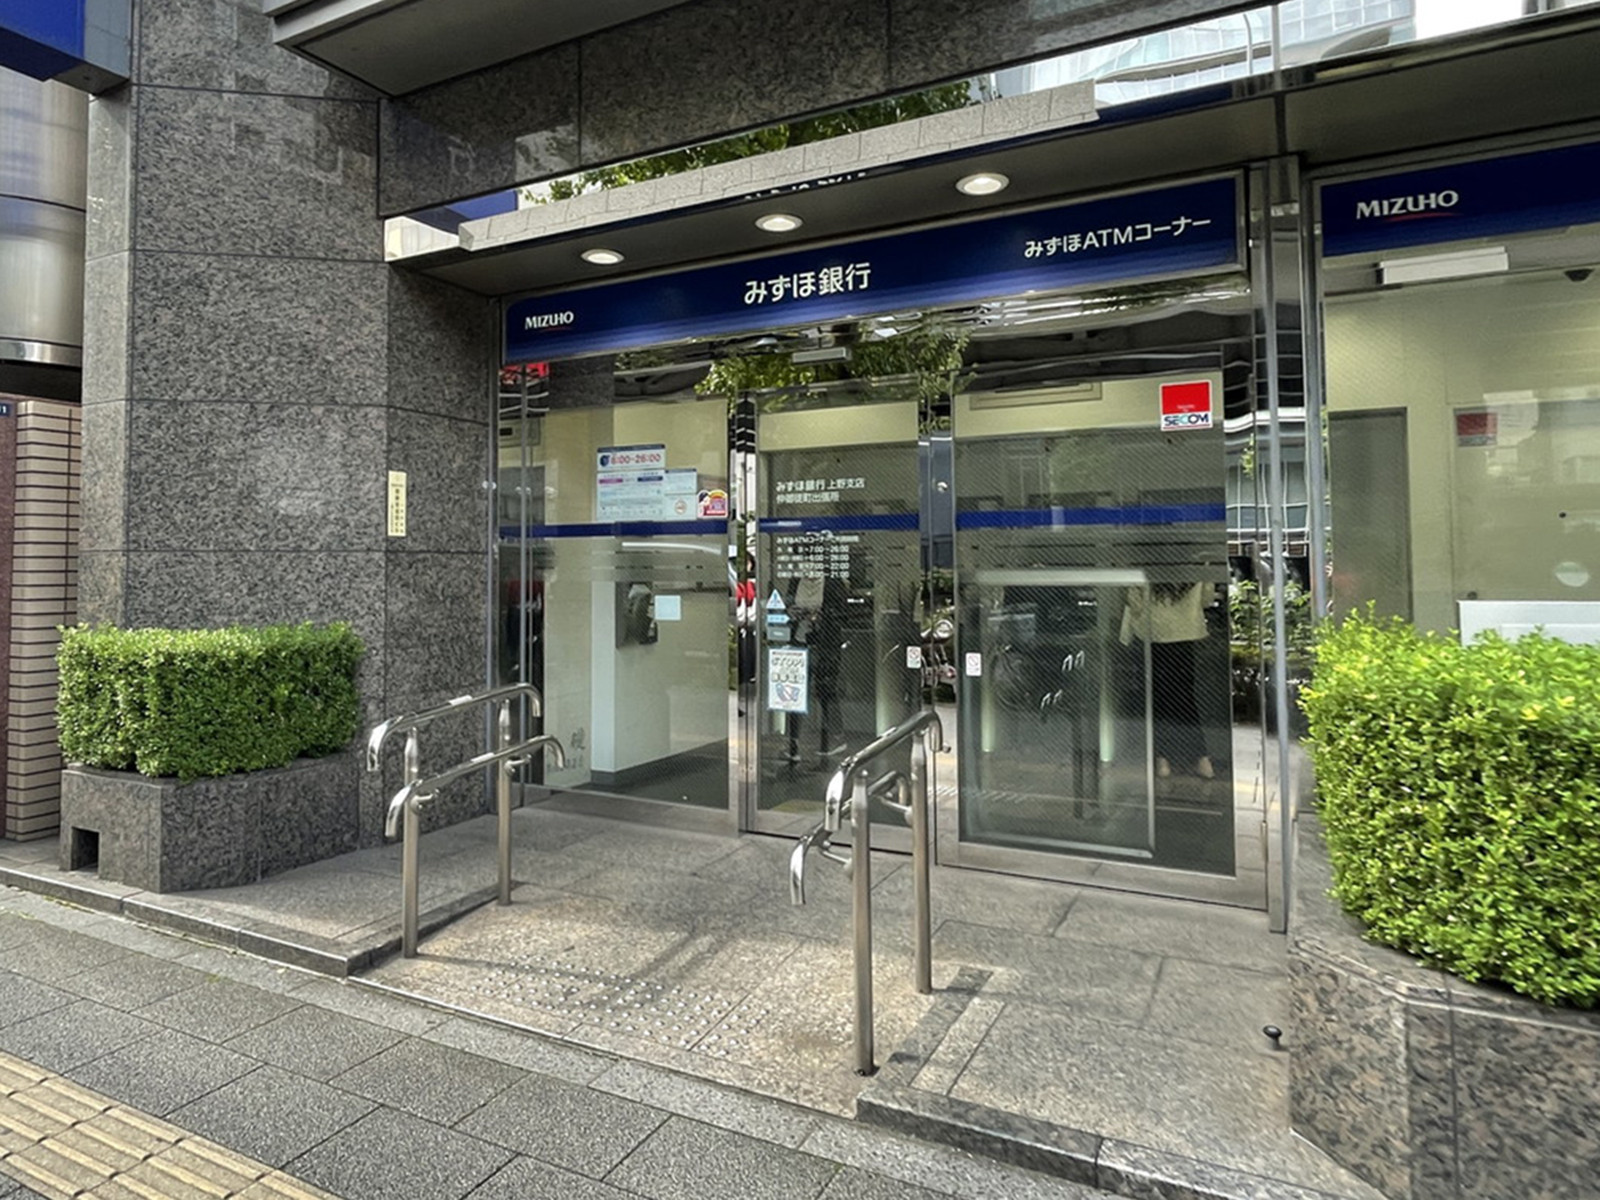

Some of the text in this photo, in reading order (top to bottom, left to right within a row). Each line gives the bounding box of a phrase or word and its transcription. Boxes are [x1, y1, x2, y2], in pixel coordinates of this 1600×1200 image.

[1355, 190, 1459, 220] MIZUHO
[1023, 215, 1212, 259] みずほATMコーナー
[743, 261, 872, 305] みずほ銀行
[524, 310, 575, 330] MIZUHO
[1163, 413, 1210, 427] SECOM
